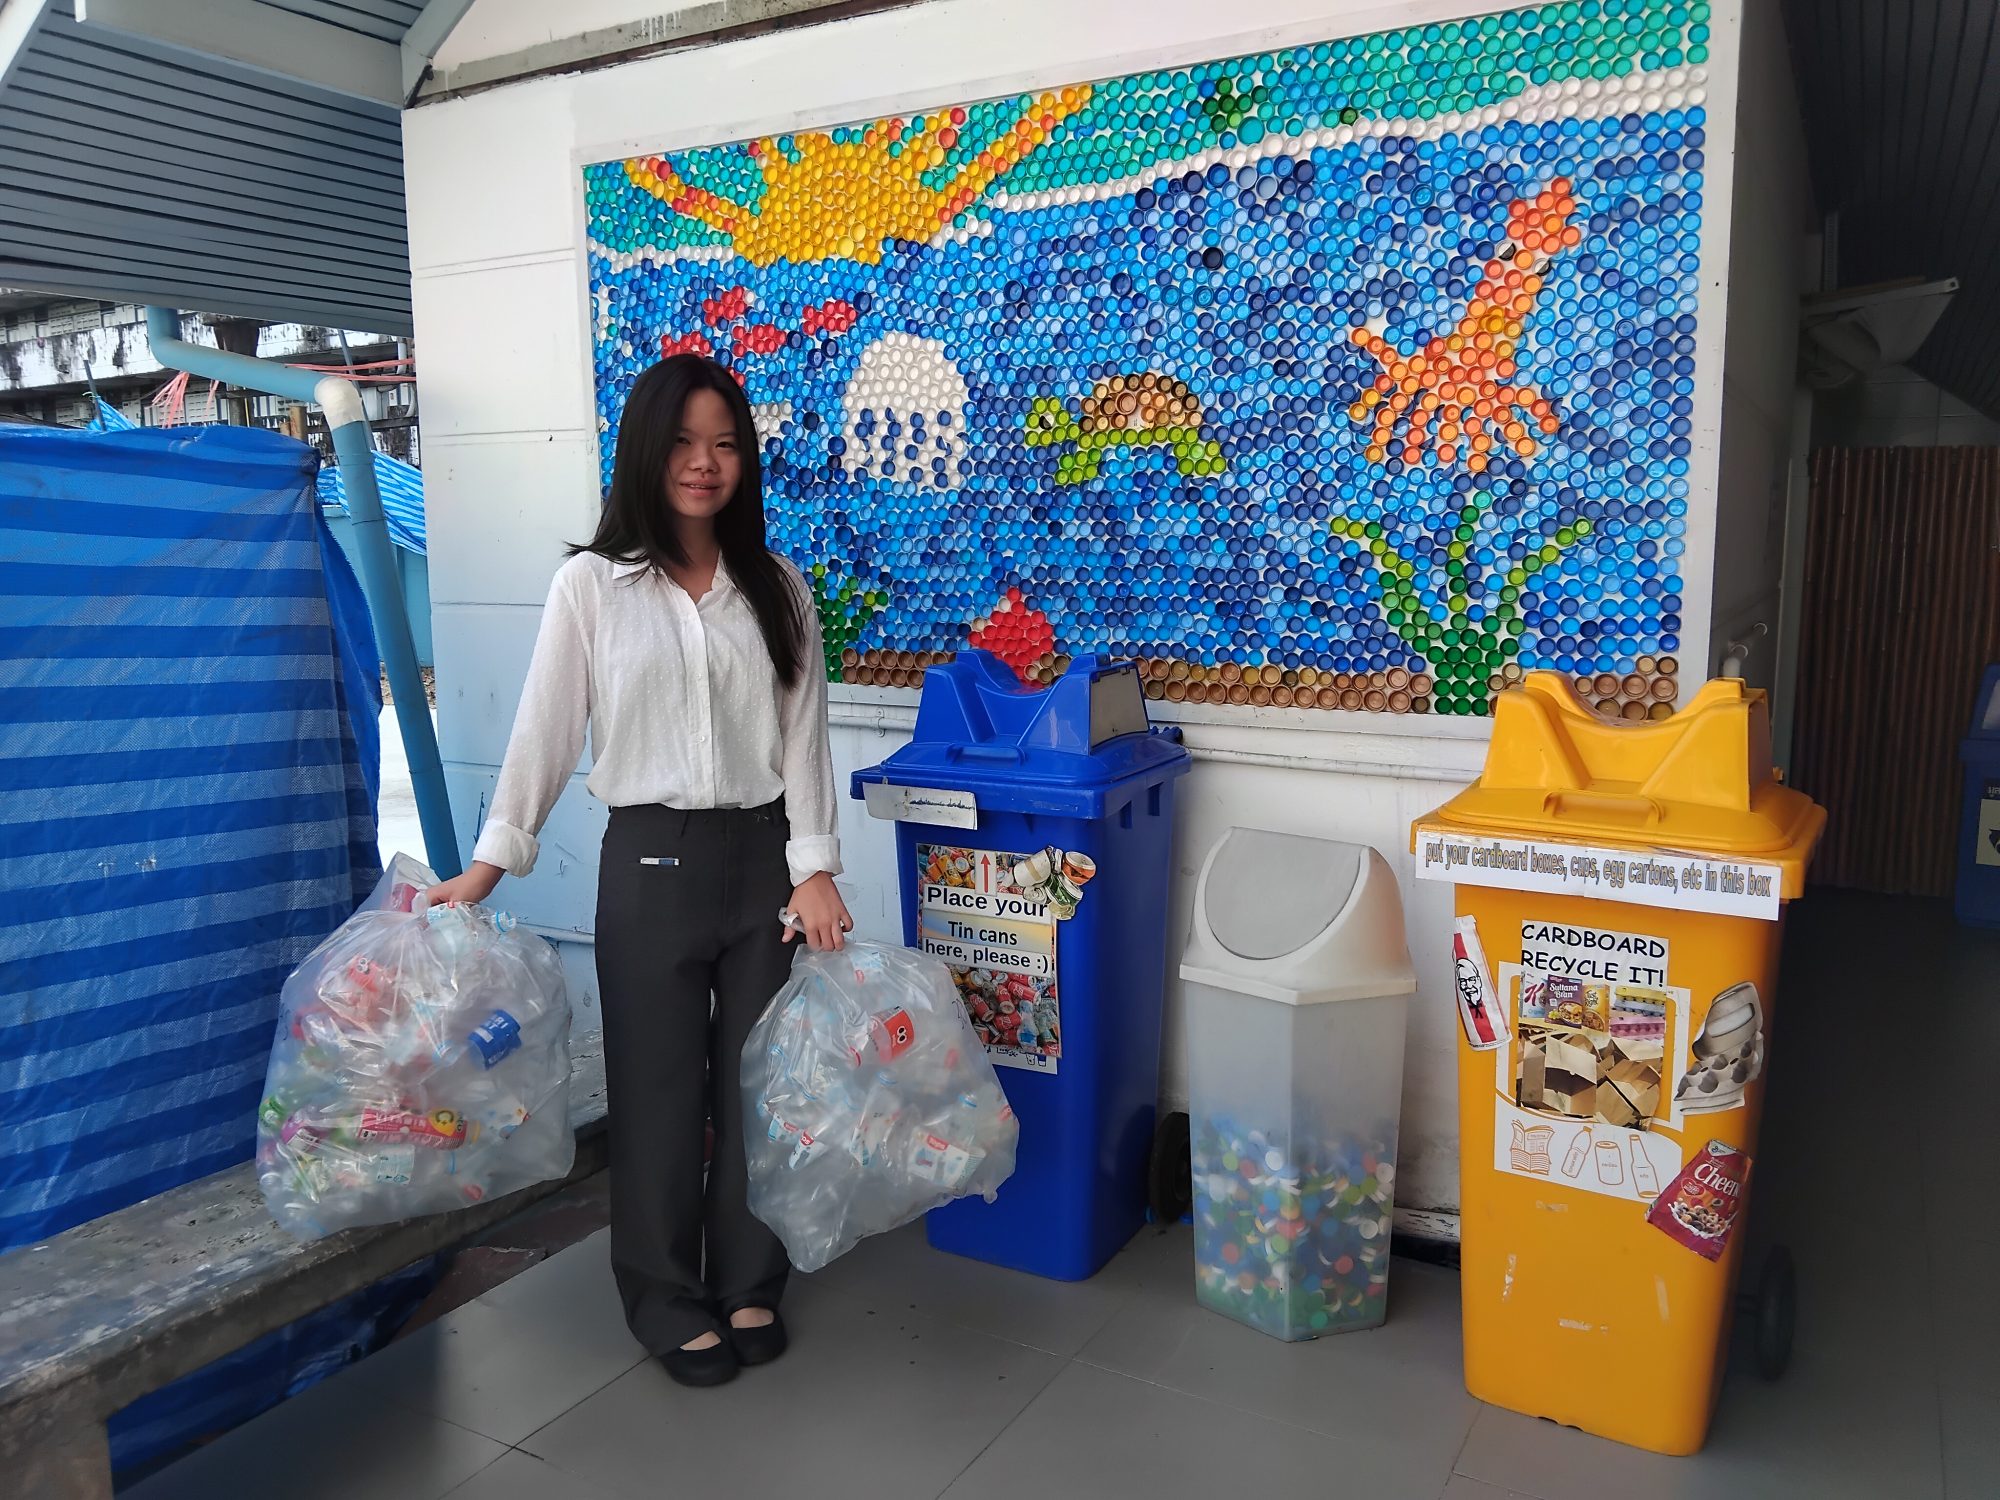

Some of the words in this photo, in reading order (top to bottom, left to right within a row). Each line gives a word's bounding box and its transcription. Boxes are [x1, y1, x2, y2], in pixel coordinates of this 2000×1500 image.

[1426, 838, 1444, 868] put
[1446, 842, 1470, 870] your
[1472, 842, 1528, 872] cardboard
[1531, 845, 1567, 882] boxes,
[1570, 855, 1600, 885] cups,
[1603, 858, 1626, 889] egg
[1628, 858, 1678, 894] cartons,
[1681, 862, 1702, 890] etc
[1705, 863, 1717, 892] in
[1720, 865, 1745, 894] this
[1747, 866, 1772, 898] box
[927, 886, 988, 910] Place
[995, 897, 1048, 917] your
[948, 920, 974, 940] Tin
[979, 928, 1018, 946] cans
[1521, 924, 1666, 959] CARDBOARD
[925, 939, 968, 962] here,
[973, 947, 1031, 968] please
[1521, 950, 1619, 982] RECYCLE
[1629, 966, 1665, 988] IT!
[1549, 982, 1579, 992] Sultana
[1553, 990, 1573, 999] Bran
